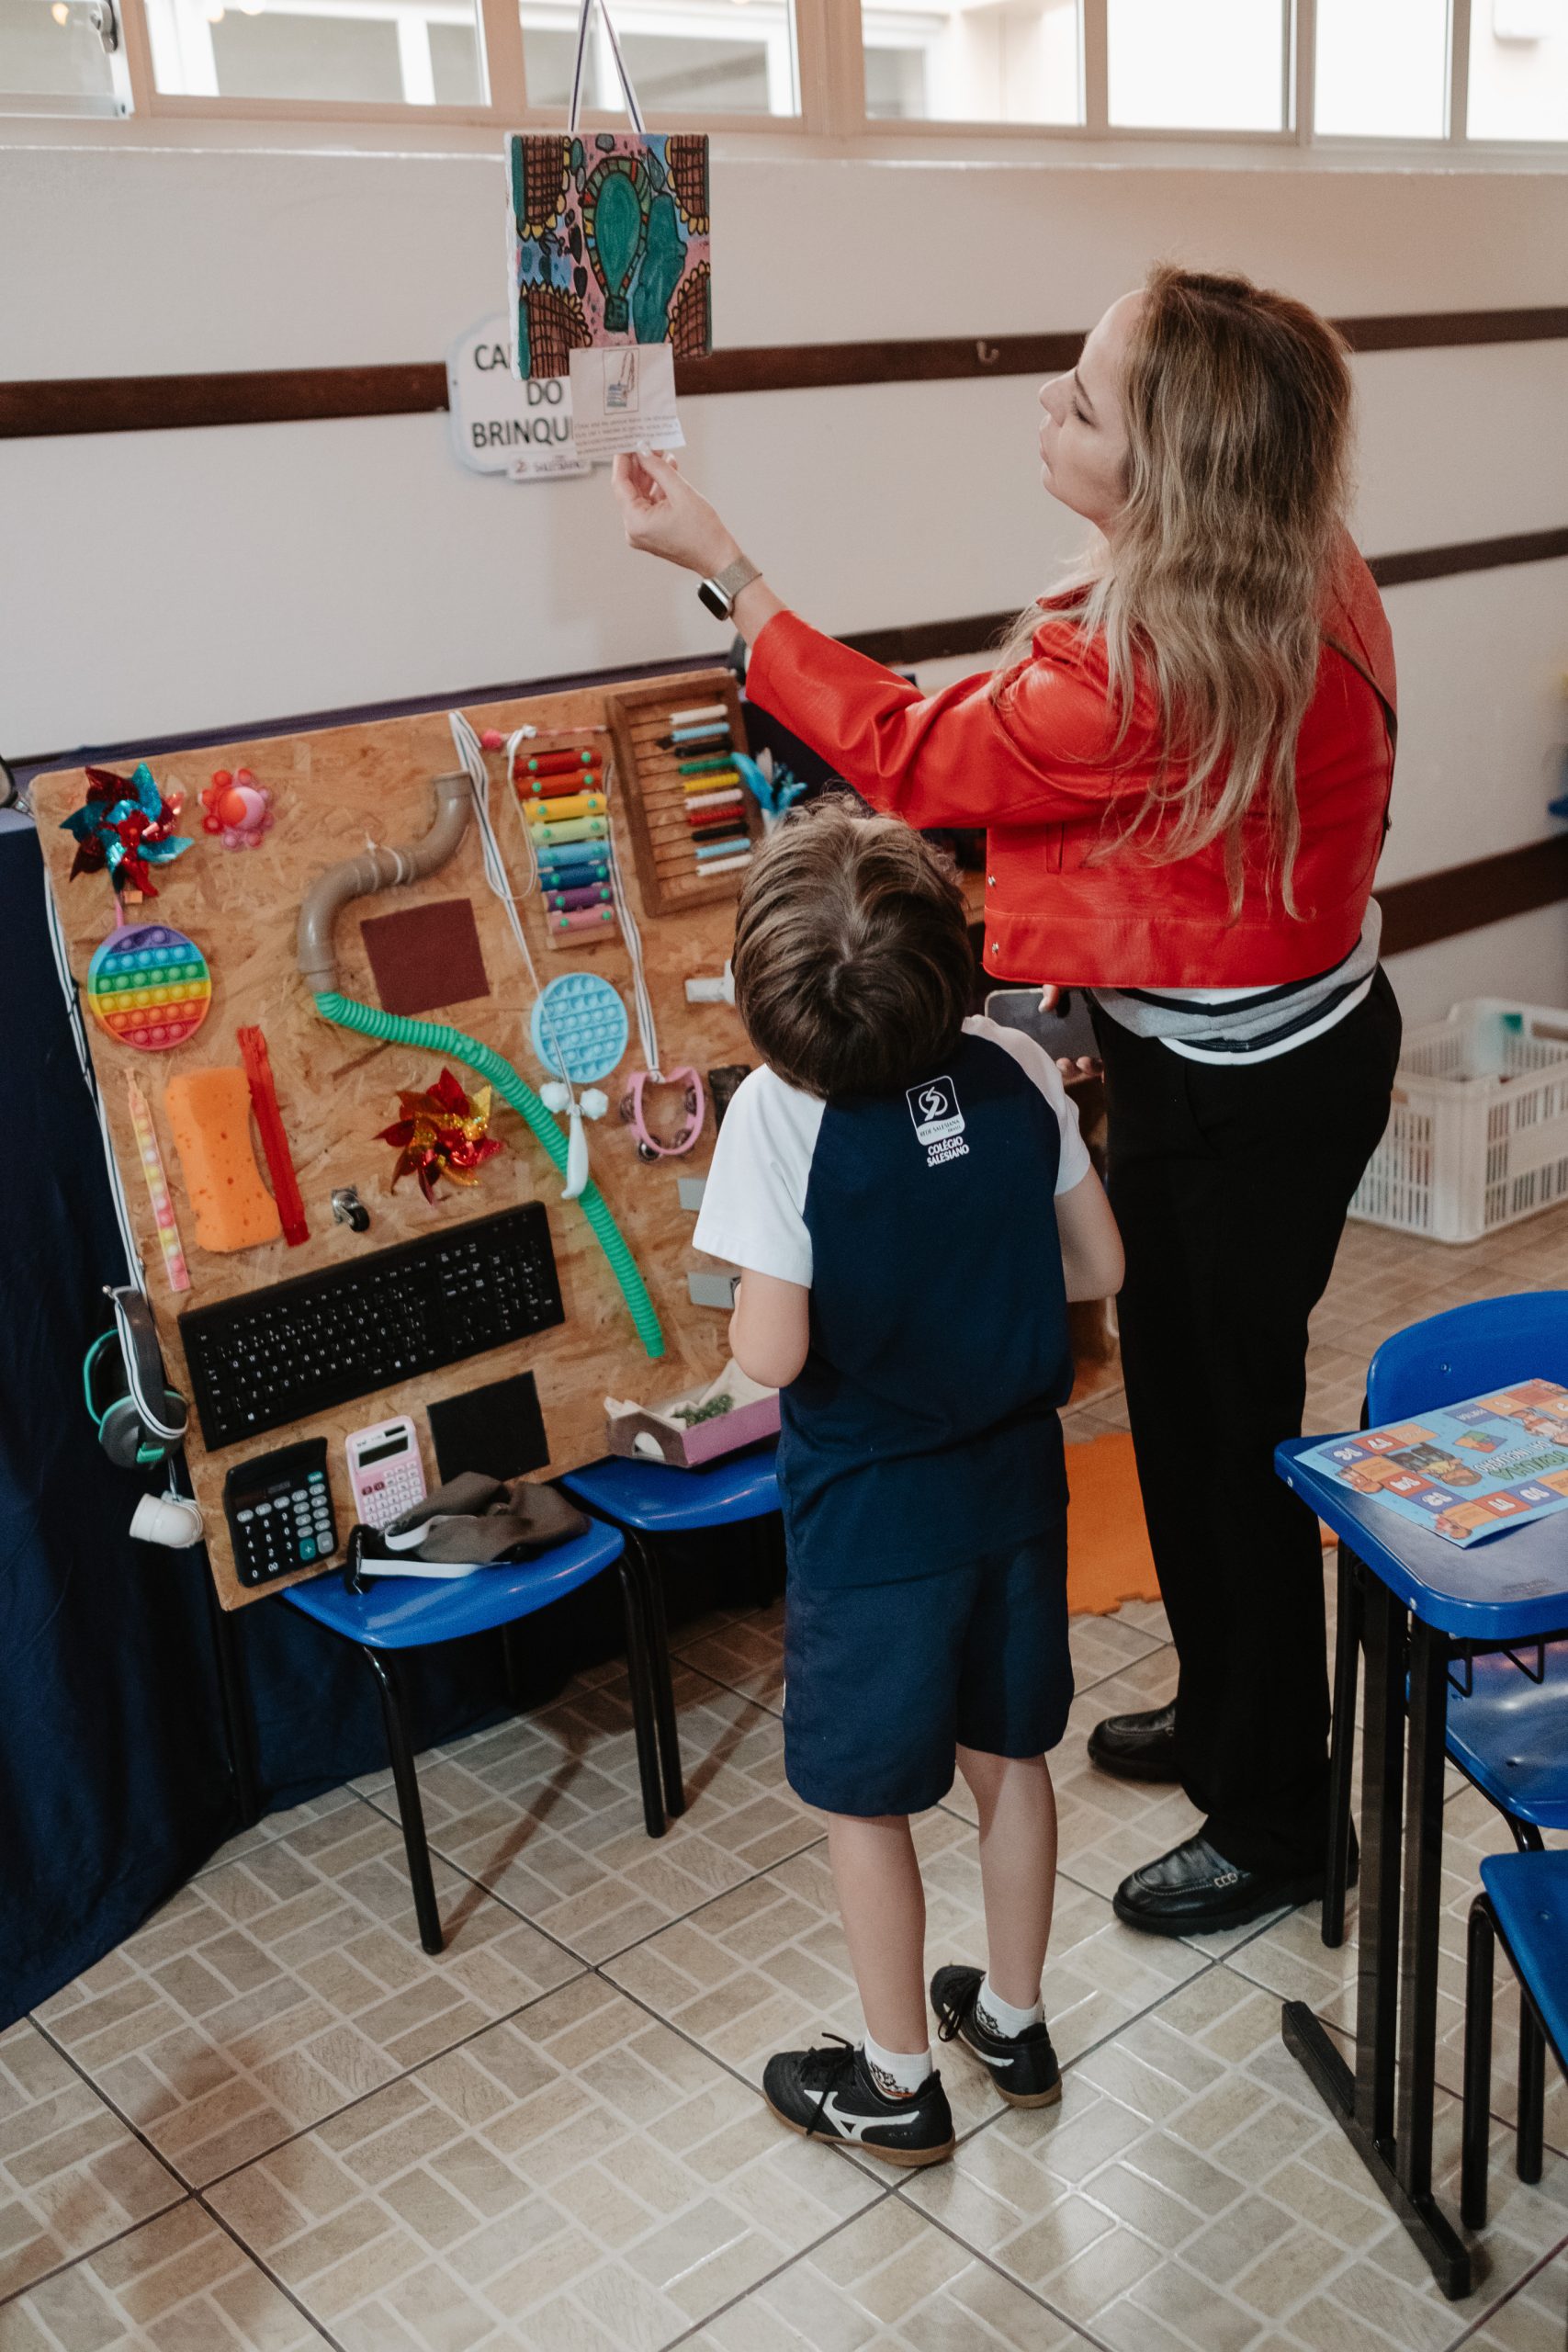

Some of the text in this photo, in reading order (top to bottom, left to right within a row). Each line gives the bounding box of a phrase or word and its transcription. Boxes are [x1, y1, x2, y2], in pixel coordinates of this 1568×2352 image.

[474, 344, 512, 370] CA
[526, 379, 563, 406] DO
[471, 416, 574, 448] BRINQU
[926, 1144, 970, 1168] SALESIANO
[927, 1136, 964, 1156] COLÉGIO
